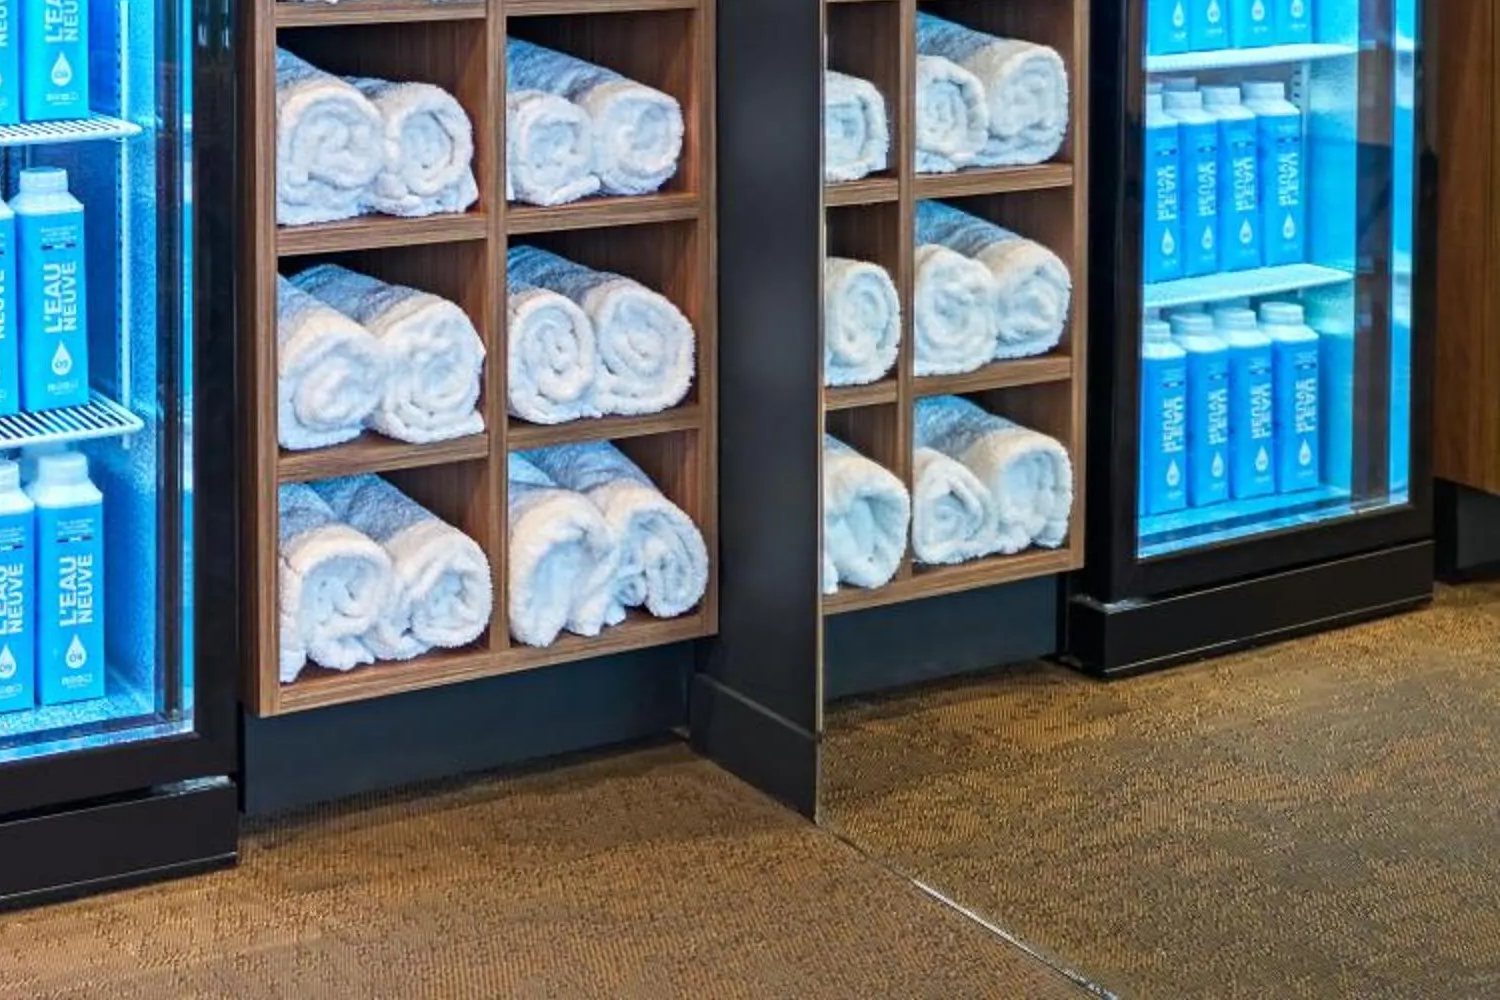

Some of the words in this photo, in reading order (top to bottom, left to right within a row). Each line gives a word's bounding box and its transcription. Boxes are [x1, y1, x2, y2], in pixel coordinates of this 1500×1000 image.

[43, 263, 62, 333] L'EAU
[61, 262, 77, 331] NEUVE
[7, 563, 23, 634] NEUVE
[59, 556, 77, 627] L'EAU
[76, 554, 93, 624] NEUVE
